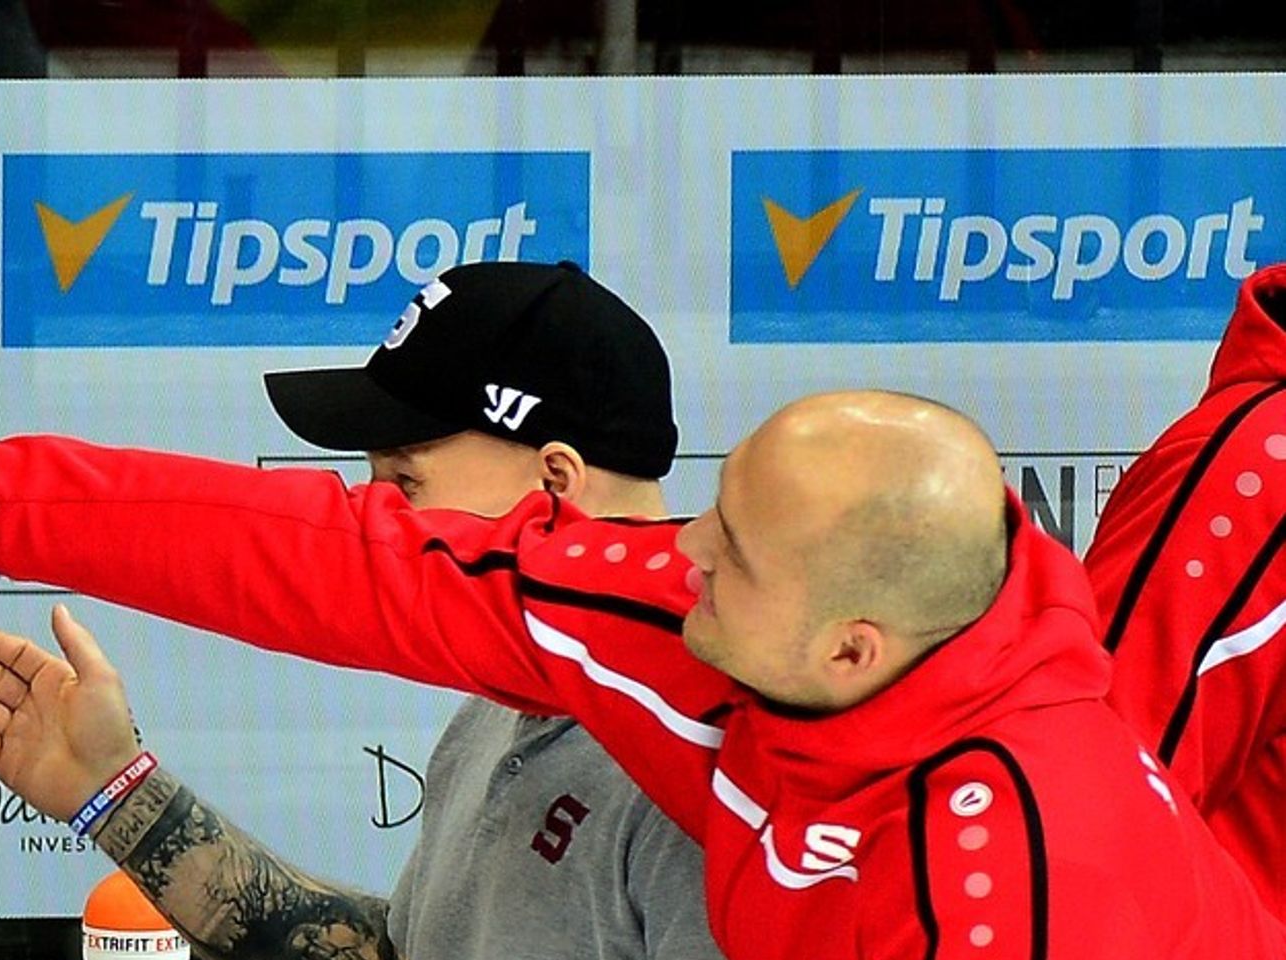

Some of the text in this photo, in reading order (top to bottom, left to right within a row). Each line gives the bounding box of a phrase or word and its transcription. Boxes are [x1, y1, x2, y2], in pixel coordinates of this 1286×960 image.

[140, 200, 536, 305] Tipsport
[868, 196, 1265, 301] Tipsport
[88, 934, 150, 952] EXTRIFIT
